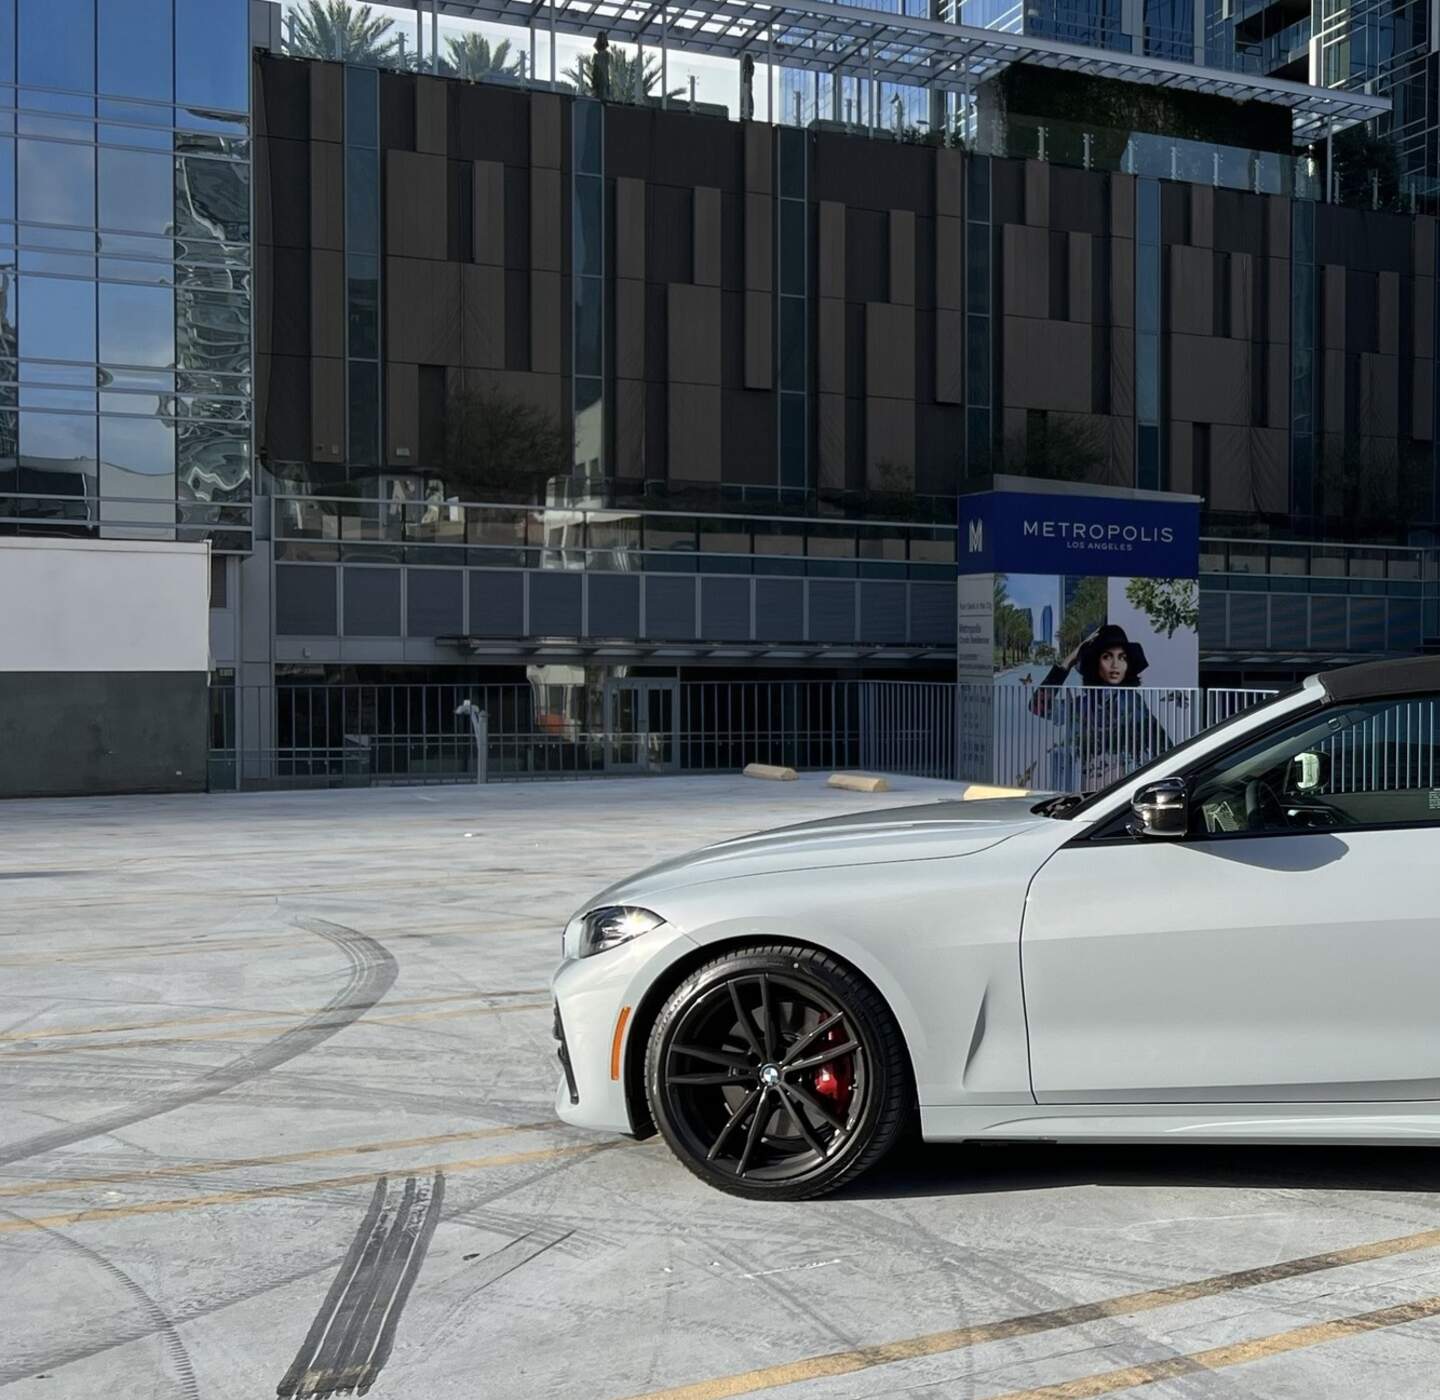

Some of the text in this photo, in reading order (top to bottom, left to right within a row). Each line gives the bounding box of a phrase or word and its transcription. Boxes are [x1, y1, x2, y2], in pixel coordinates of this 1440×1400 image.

[968, 518, 983, 553] M
[1023, 520, 1174, 543] METROPOLIS
[1066, 541, 1133, 551] LOS ANGELES
